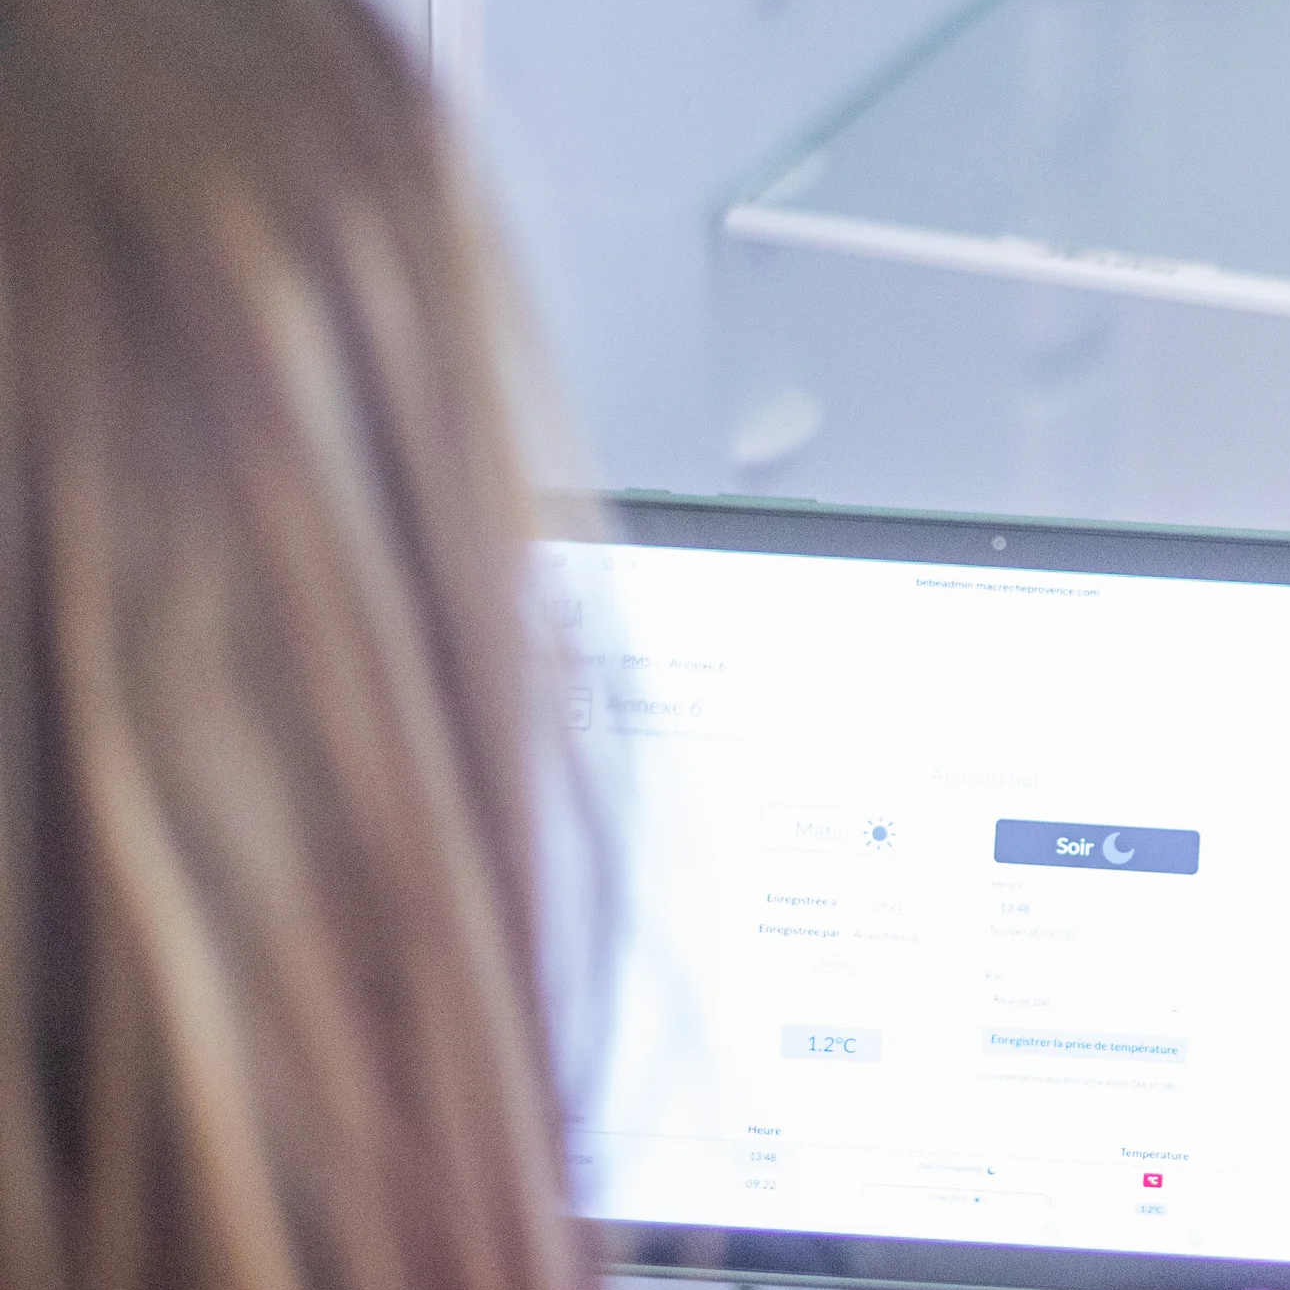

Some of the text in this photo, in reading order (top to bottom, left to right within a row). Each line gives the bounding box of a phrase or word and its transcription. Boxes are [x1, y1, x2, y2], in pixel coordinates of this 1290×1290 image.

[690, 699, 702, 717] 6
[1055, 836, 1095, 857] Soir
[808, 1036, 857, 1054] 1.2°C
[991, 1034, 1050, 1047] Enregistrer
[1054, 1039, 1063, 1048] la
[1065, 1040, 1092, 1050] prise
[1095, 1041, 1107, 1051] de
[748, 1125, 782, 1136] Heure
